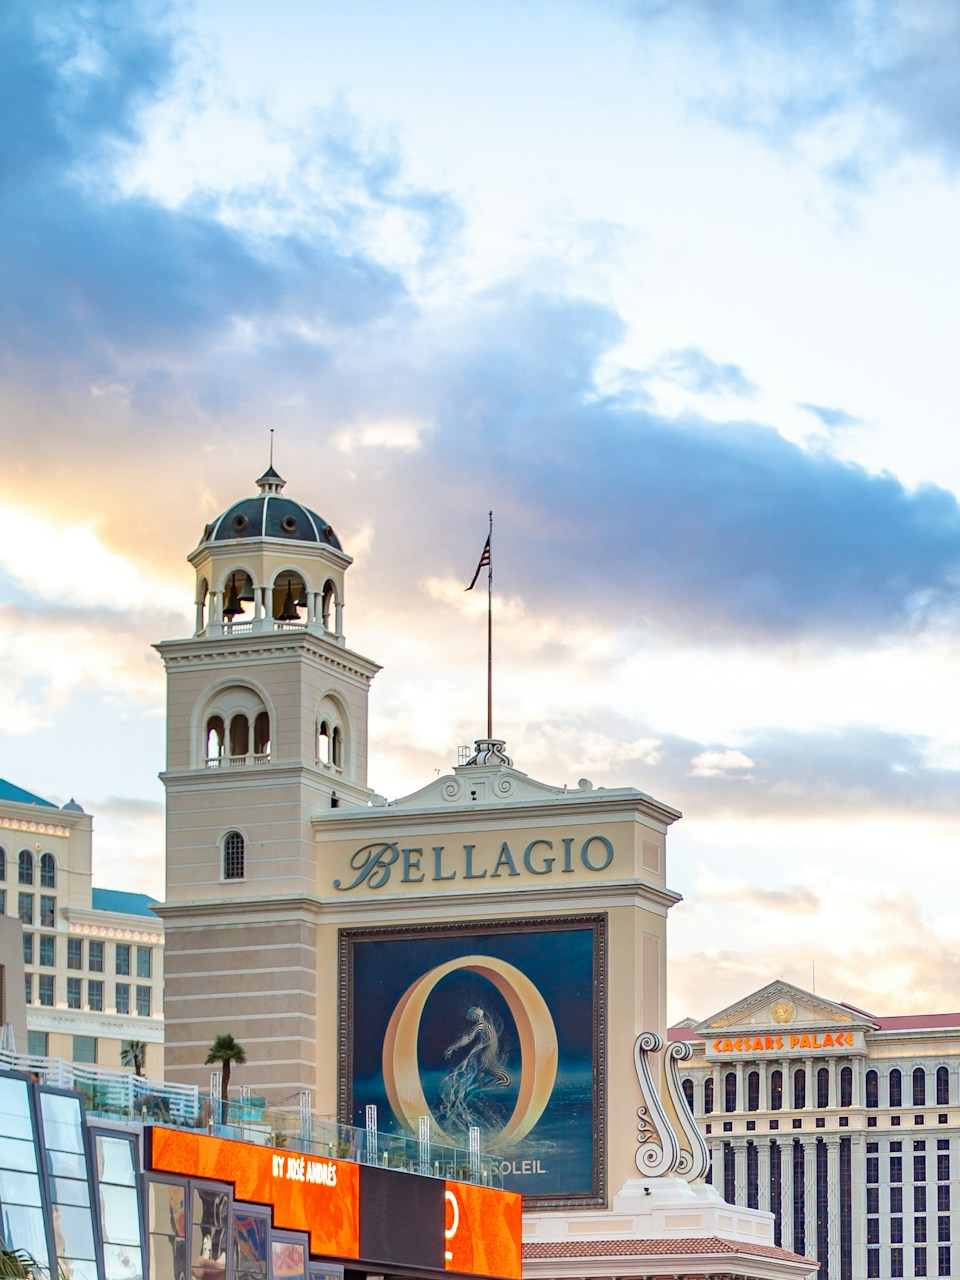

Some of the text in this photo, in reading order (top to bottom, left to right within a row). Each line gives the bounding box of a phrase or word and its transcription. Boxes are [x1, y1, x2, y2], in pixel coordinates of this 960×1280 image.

[333, 835, 614, 891] BELLAGIO
[712, 1031, 854, 1053] CAESARS PALACE
[272, 1153, 337, 1186] BY JOSÉ ANDRÉS
[491, 1160, 546, 1176] SOLEIL
